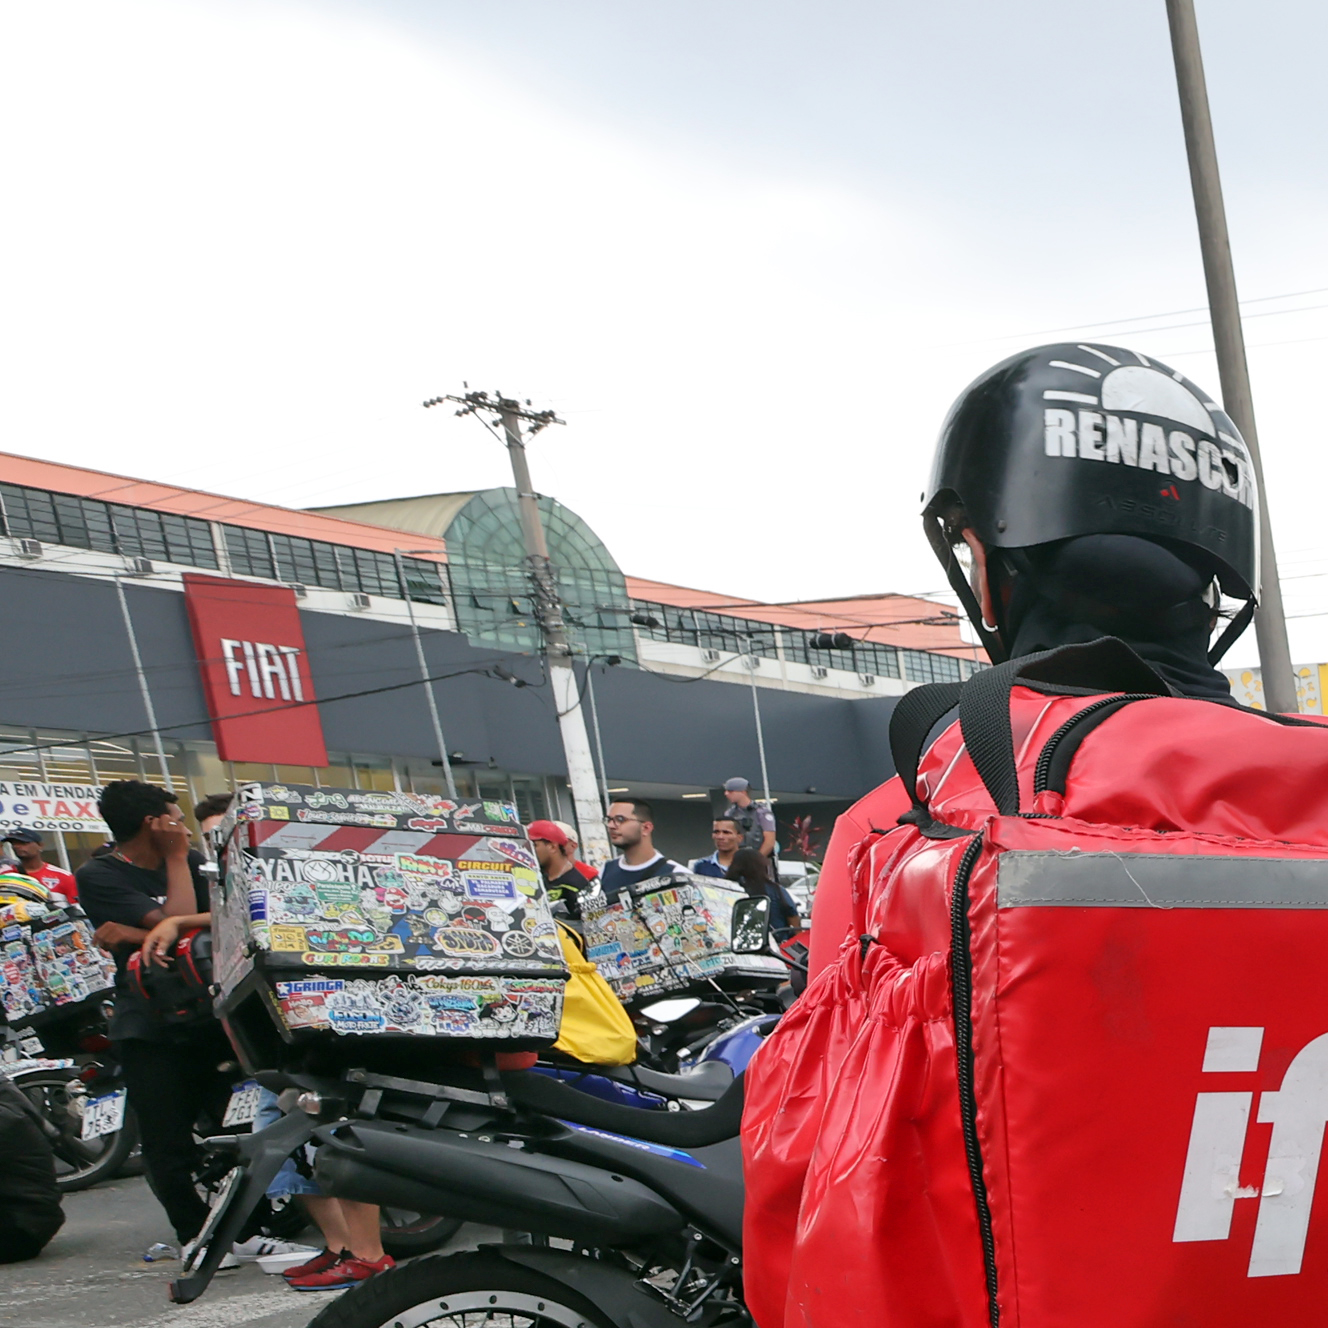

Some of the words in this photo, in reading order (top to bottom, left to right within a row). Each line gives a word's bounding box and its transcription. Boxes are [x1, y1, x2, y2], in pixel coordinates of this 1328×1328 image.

[220, 637, 303, 702] FIAT
[13, 783, 39, 797] EM
[42, 785, 103, 800] VENDAS
[13, 803, 29, 816] e
[31, 799, 103, 818] TAX
[259, 857, 375, 889] YAHA
[457, 860, 513, 872] CIRCUIT
[293, 980, 344, 993] GRINGA
